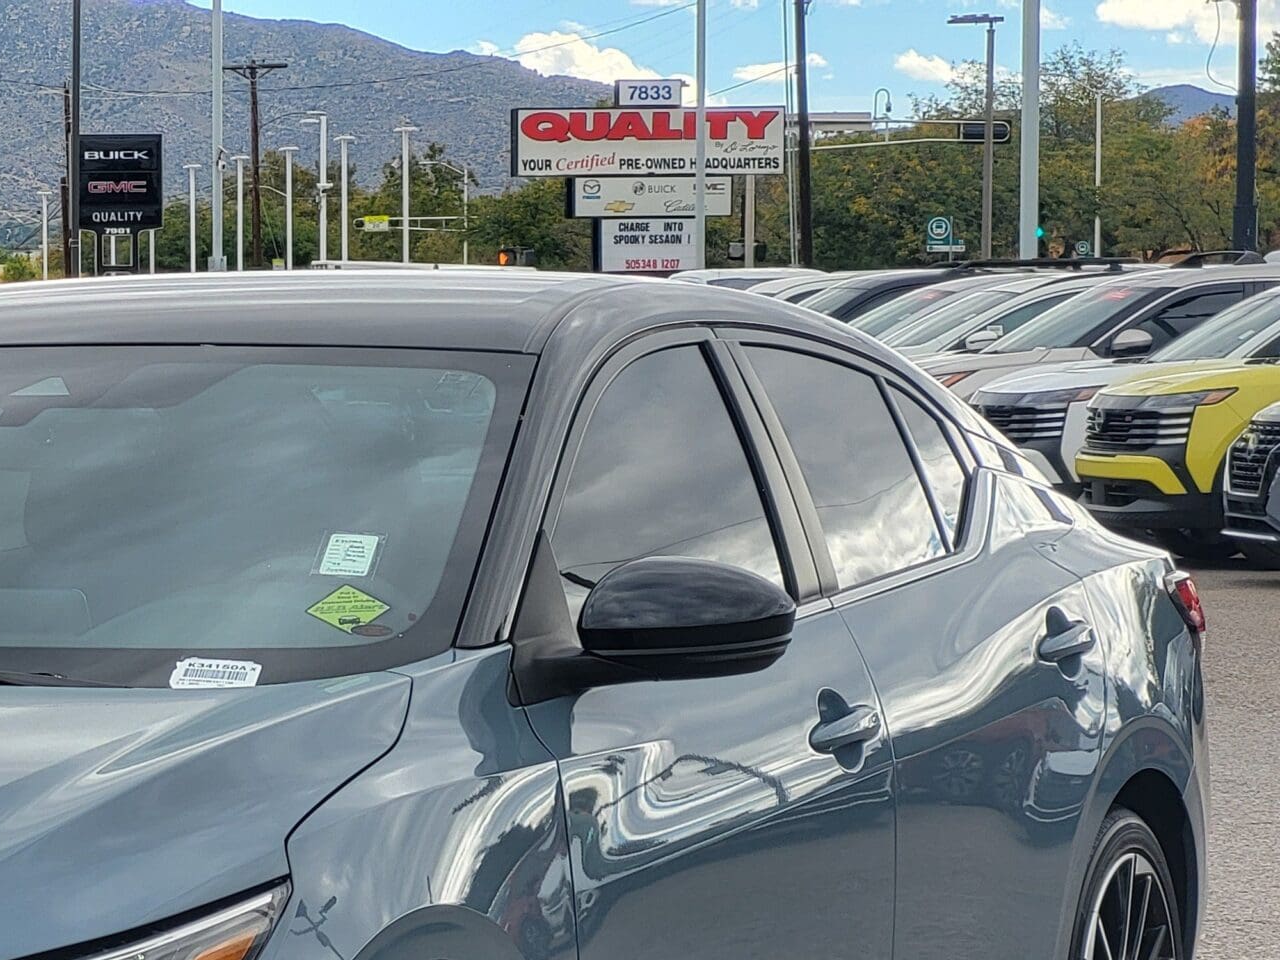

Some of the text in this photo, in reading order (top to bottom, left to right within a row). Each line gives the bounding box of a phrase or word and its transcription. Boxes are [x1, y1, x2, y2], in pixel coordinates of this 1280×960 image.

[628, 85, 672, 100] 7833
[520, 111, 779, 143] QUALITY
[84, 150, 150, 160] BUICK
[521, 152, 780, 172] YOUR Certified PRE-OWNED HADQUARTERS
[88, 181, 147, 193] GMC
[647, 184, 677, 194] BUICK
[92, 211, 143, 222] QUALITY
[618, 222, 683, 232] CHARGE INTO
[613, 235, 646, 245] SPOOKY
[648, 234, 682, 245] SESAON
[661, 259, 680, 269] 1207
